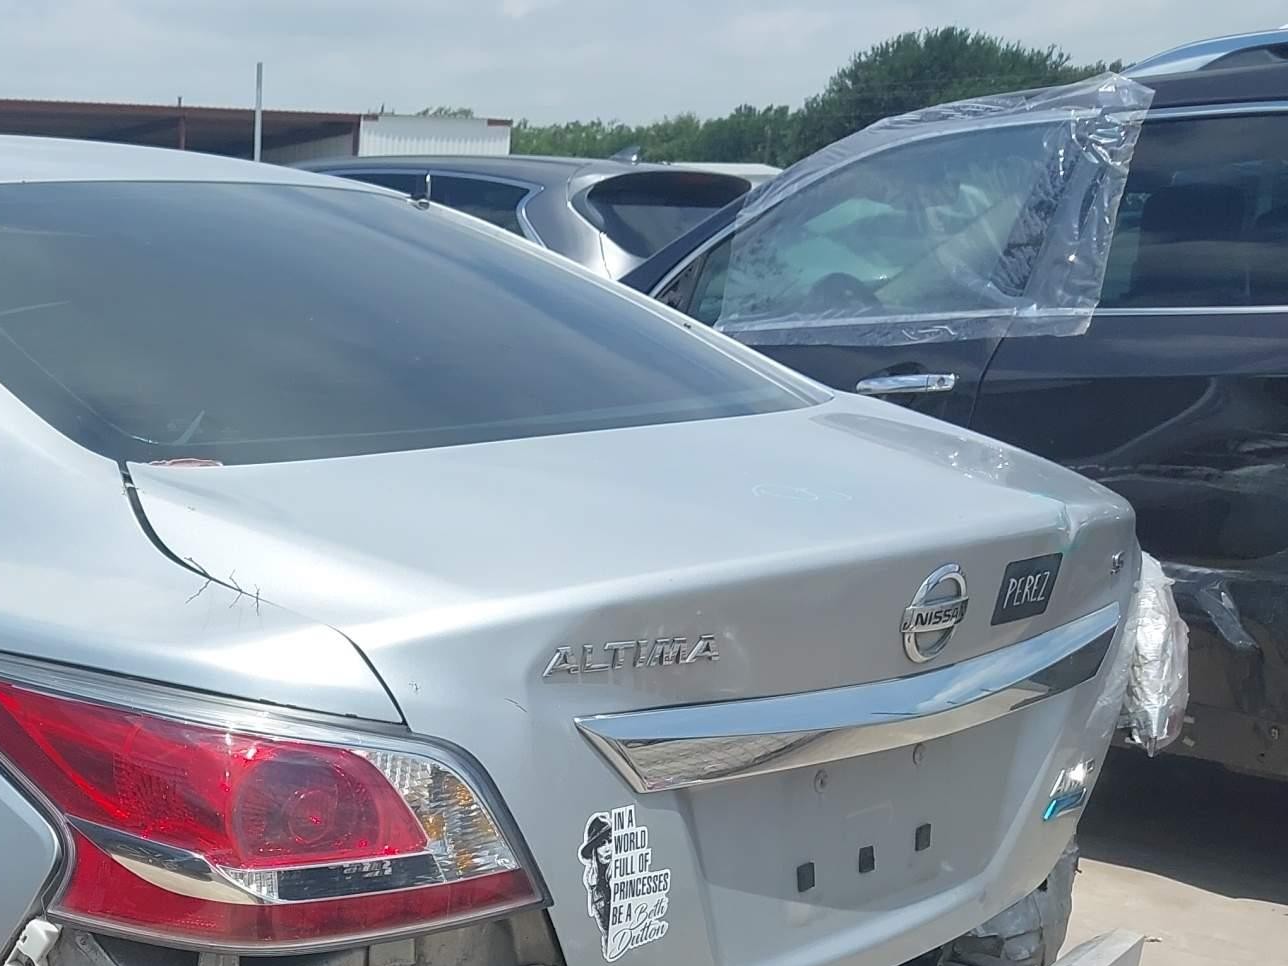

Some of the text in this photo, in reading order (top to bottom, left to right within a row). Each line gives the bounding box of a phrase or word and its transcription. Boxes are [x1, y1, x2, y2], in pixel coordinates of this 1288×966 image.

[1003, 572, 1050, 608] PEREZ
[913, 602, 968, 628] NISSAN
[541, 634, 720, 678] ALTIMA
[614, 809, 634, 831] IN A
[614, 830, 646, 854] WORLD
[614, 853, 649, 879] FULL OF
[613, 871, 669, 903] PRINCESSES
[612, 898, 665, 929] BE A Beth
[609, 923, 666, 960] Dutton
